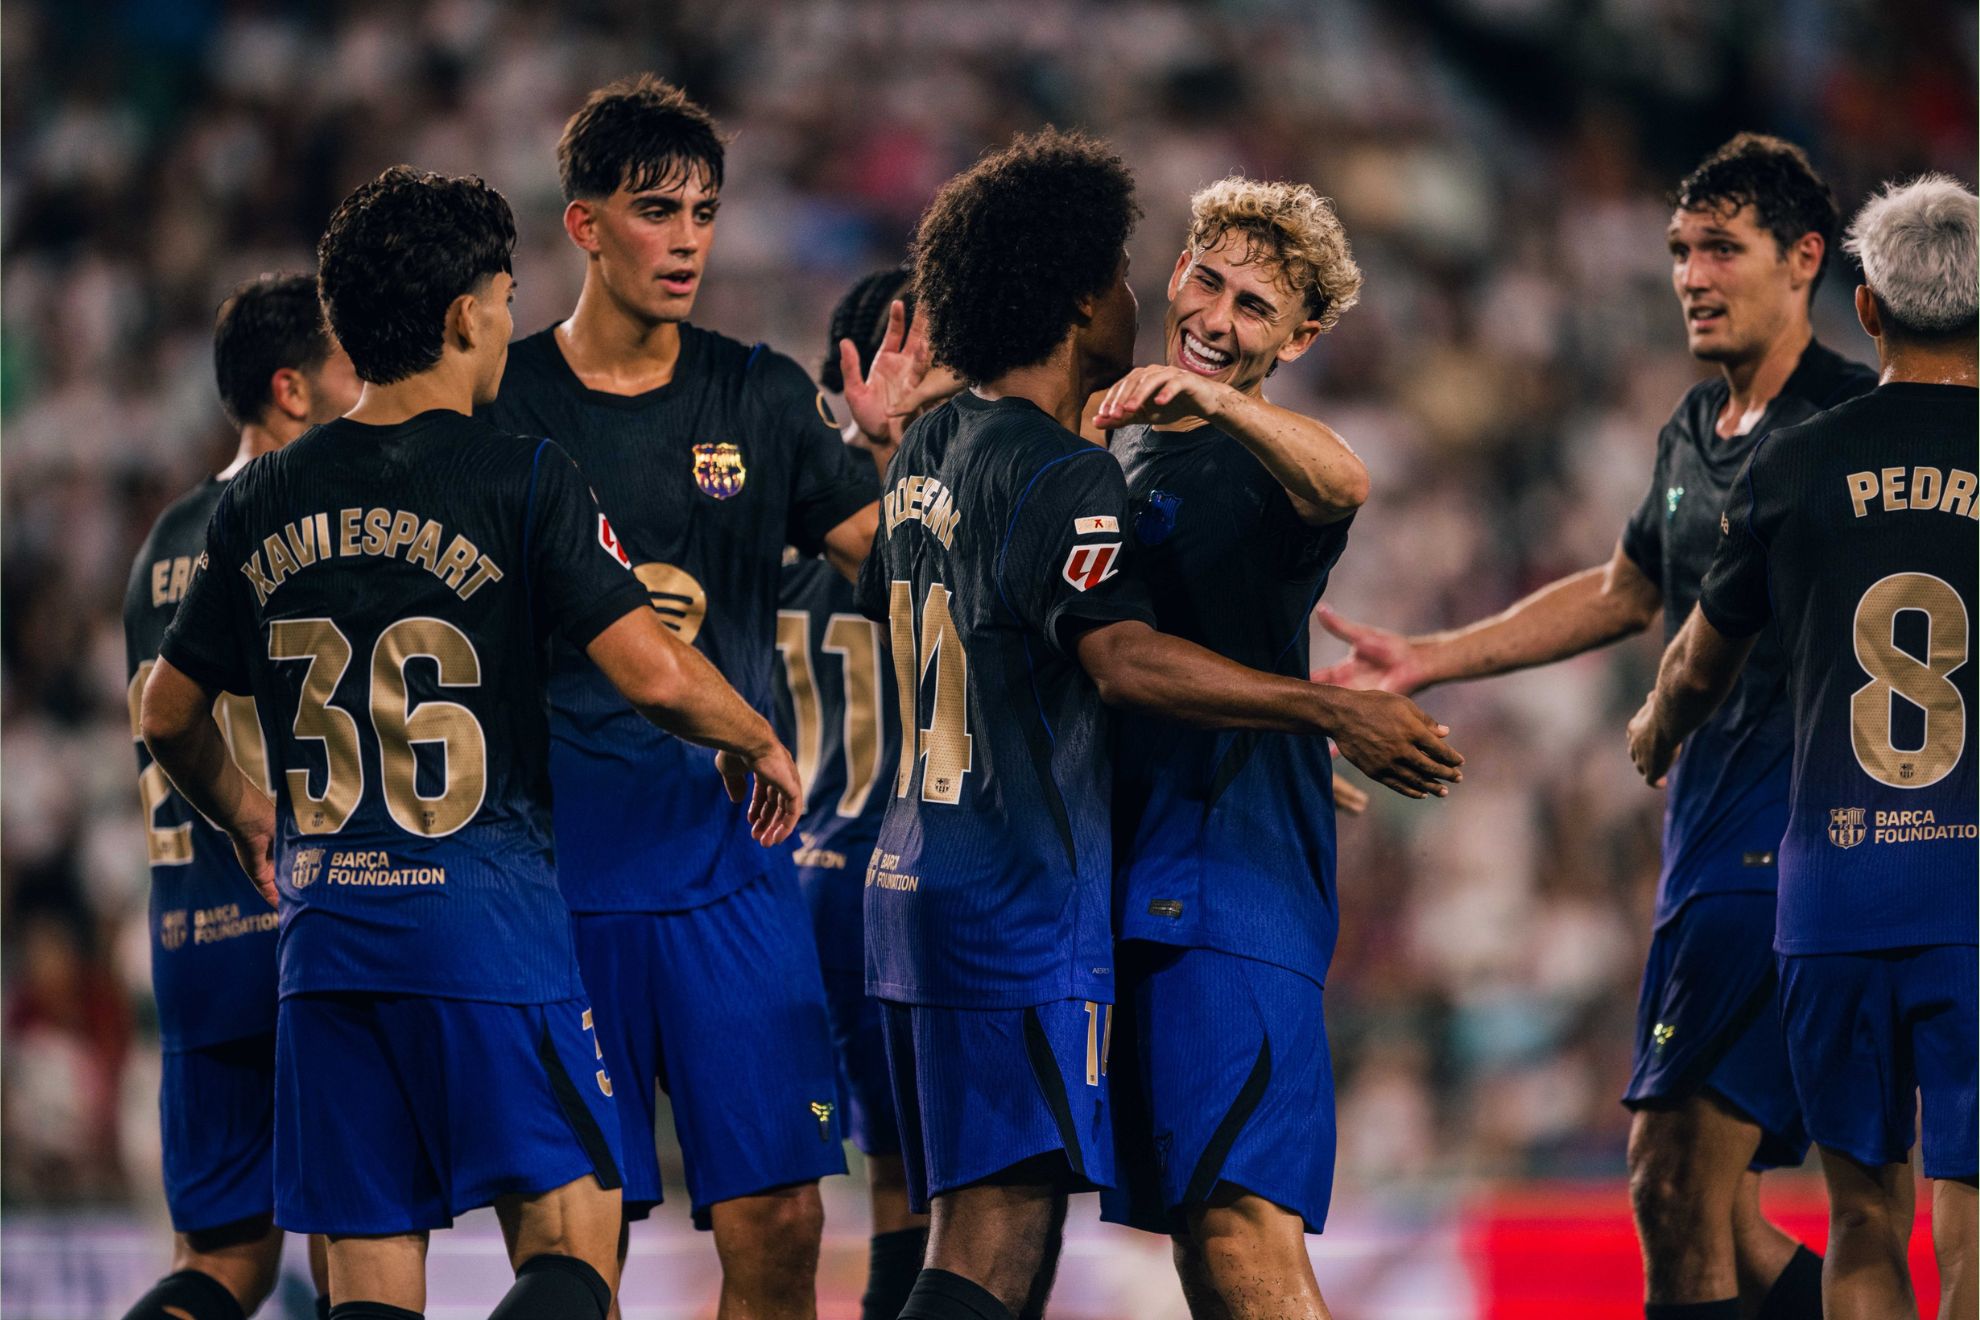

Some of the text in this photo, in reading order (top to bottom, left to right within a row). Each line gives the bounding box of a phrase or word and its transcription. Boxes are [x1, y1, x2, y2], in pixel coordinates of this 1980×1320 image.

[240, 507, 504, 607] XAVI ESPART
[268, 616, 487, 838] 36
[776, 610, 884, 818] 11
[889, 580, 972, 804] 14
[1850, 571, 1969, 789] 8
[327, 867, 445, 886] FOUNDATION
[330, 851, 390, 870] BARÇA
[1875, 810, 1935, 827] BARÇA
